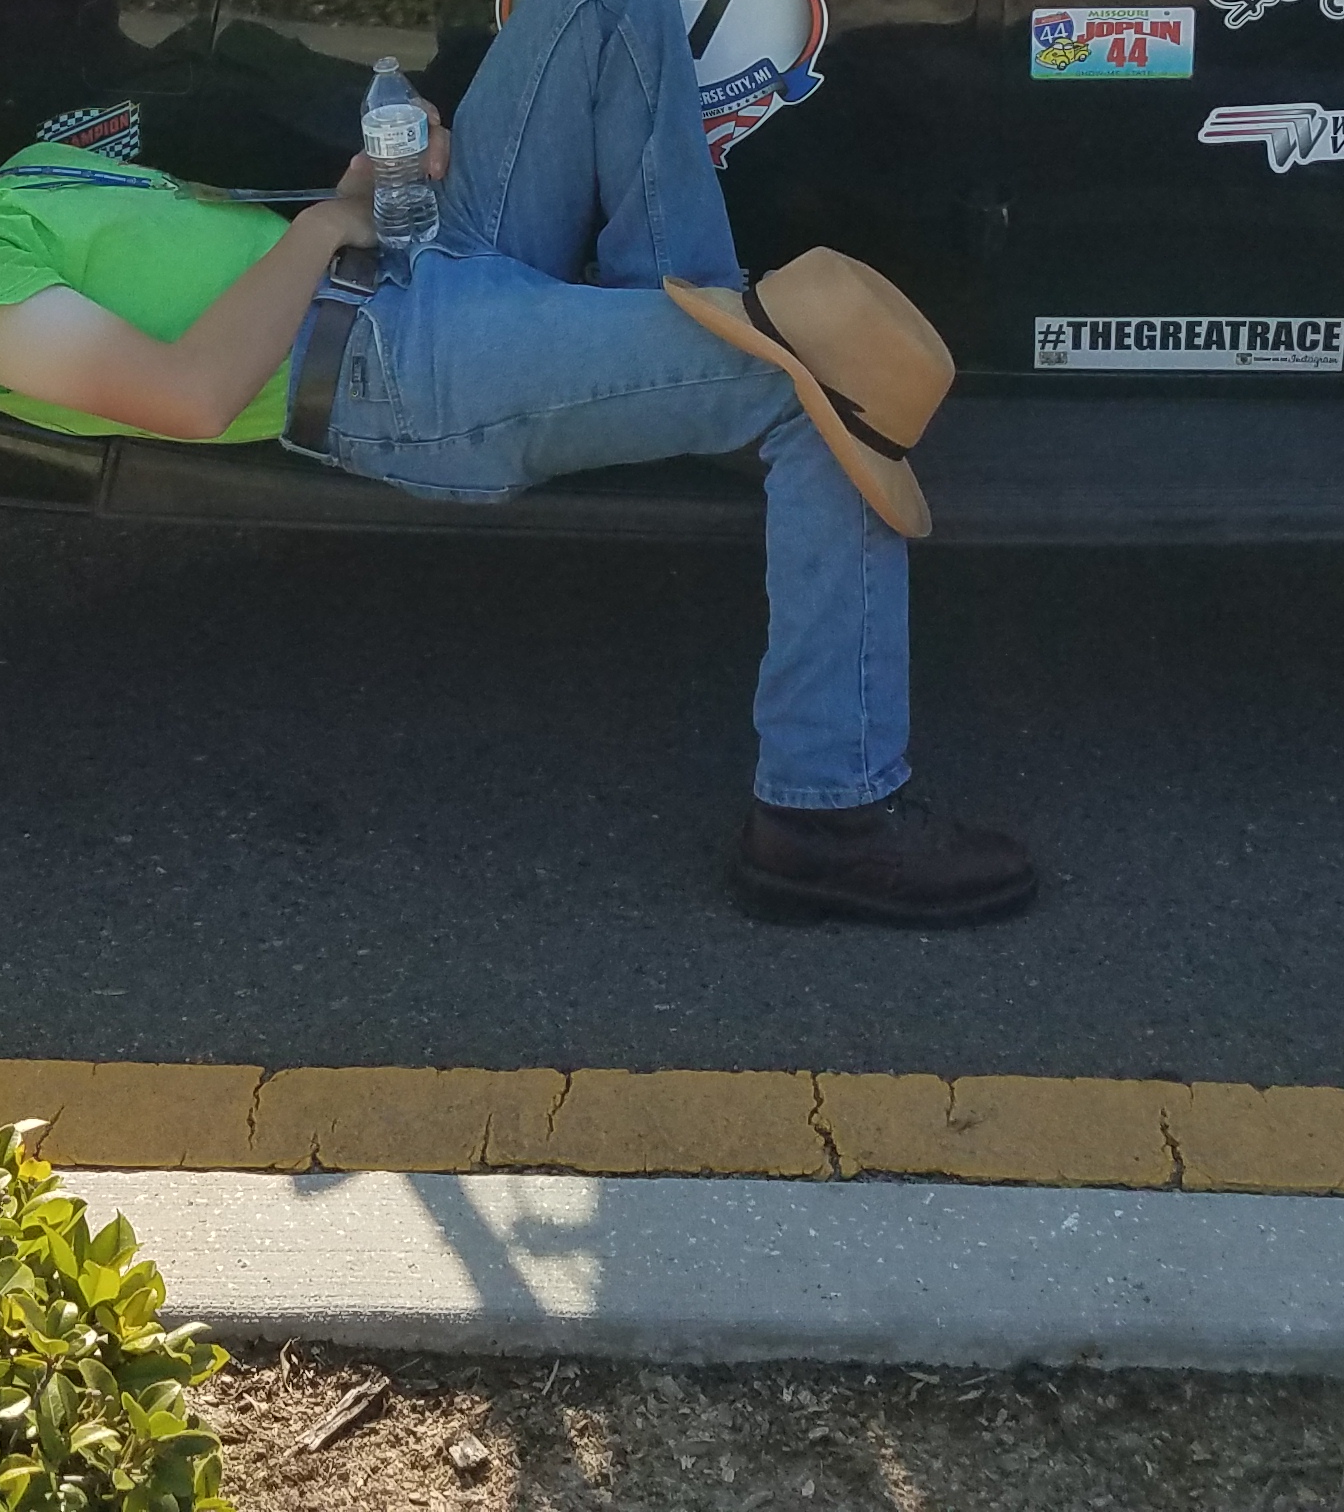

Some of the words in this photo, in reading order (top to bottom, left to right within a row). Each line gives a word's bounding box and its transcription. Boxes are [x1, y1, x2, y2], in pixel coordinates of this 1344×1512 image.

[1087, 9, 1150, 19] MISSOURI
[1040, 22, 1069, 44] 44
[1076, 21, 1182, 46] JOPLIN
[1106, 37, 1149, 68] 44
[725, 75, 756, 97] CITY,
[752, 66, 773, 85] MI
[64, 111, 130, 148] AMPION
[1037, 320, 1343, 352] #THEGREATRACE
